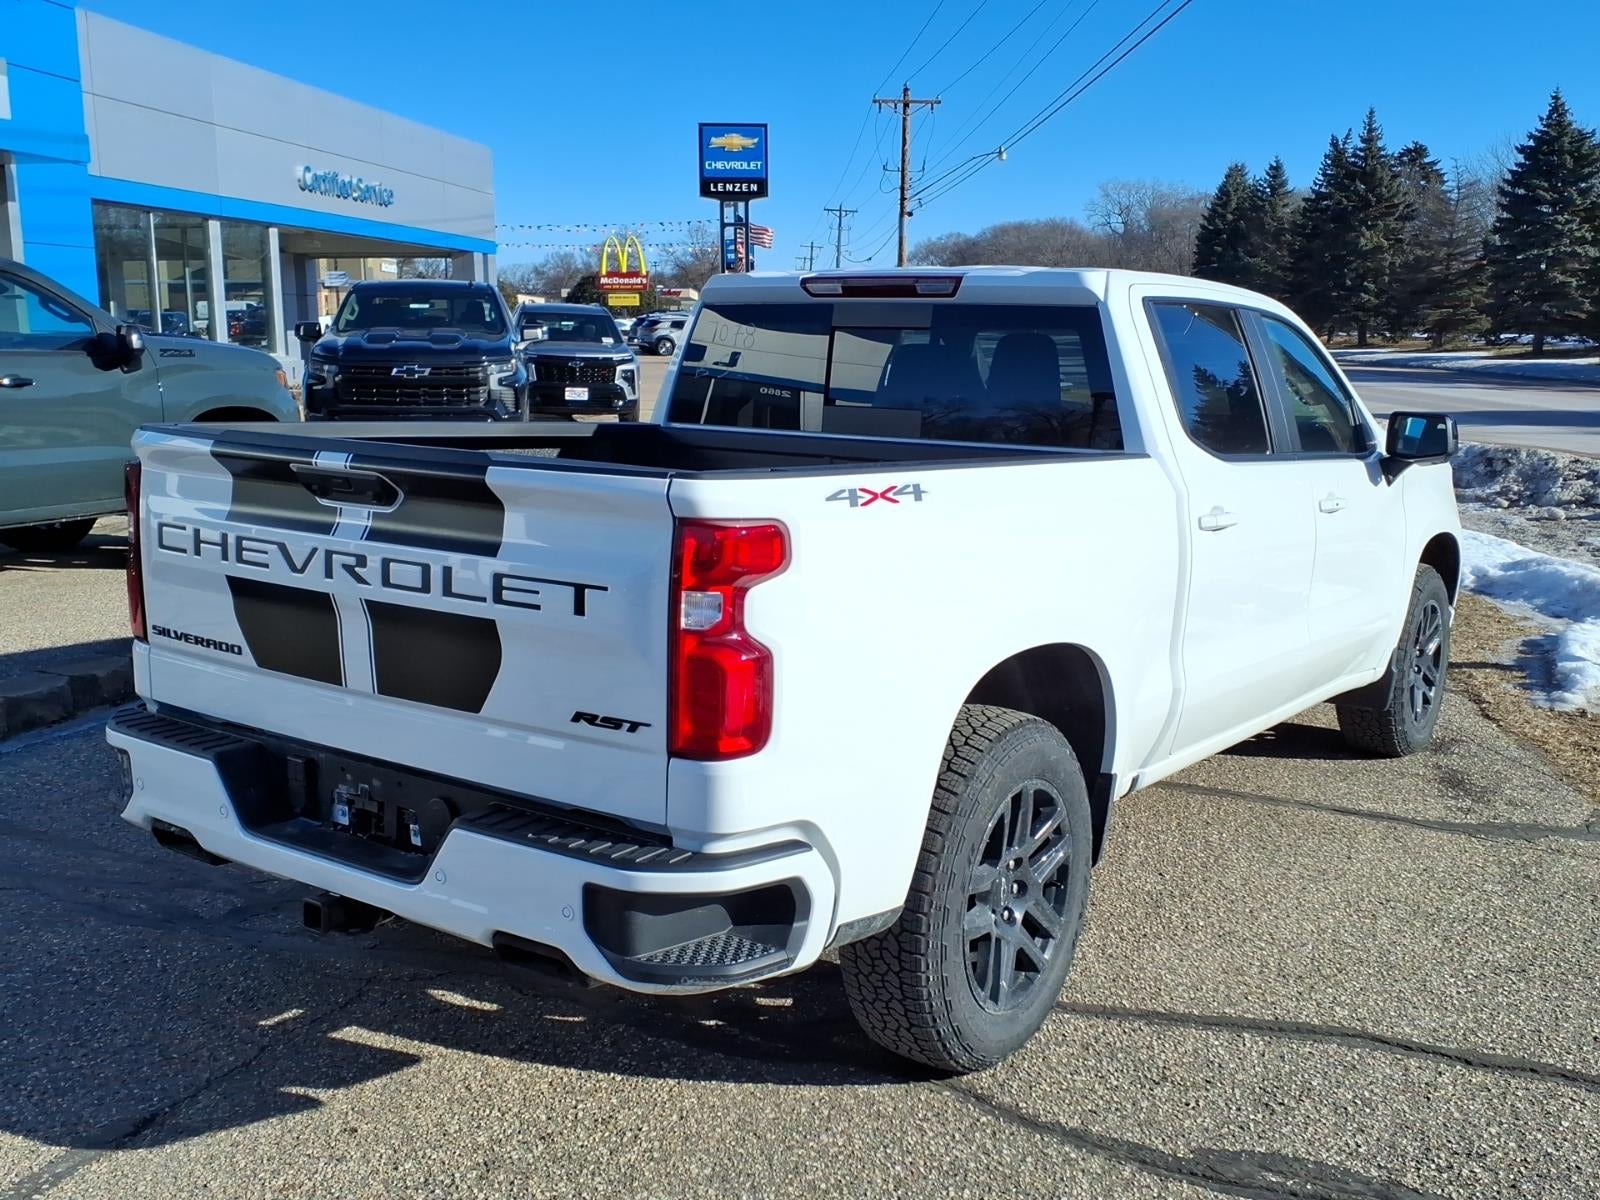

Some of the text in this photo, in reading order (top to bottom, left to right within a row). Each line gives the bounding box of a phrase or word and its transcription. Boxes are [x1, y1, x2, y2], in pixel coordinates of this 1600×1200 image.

[705, 160, 762, 170] CHEVROLET
[299, 165, 394, 206] Certified Service
[710, 183, 758, 192] LENZEN
[600, 276, 647, 285] McDonald's
[157, 521, 609, 617] CHEVROLET
[151, 623, 243, 656] SILVERADO
[570, 710, 652, 733] RST
